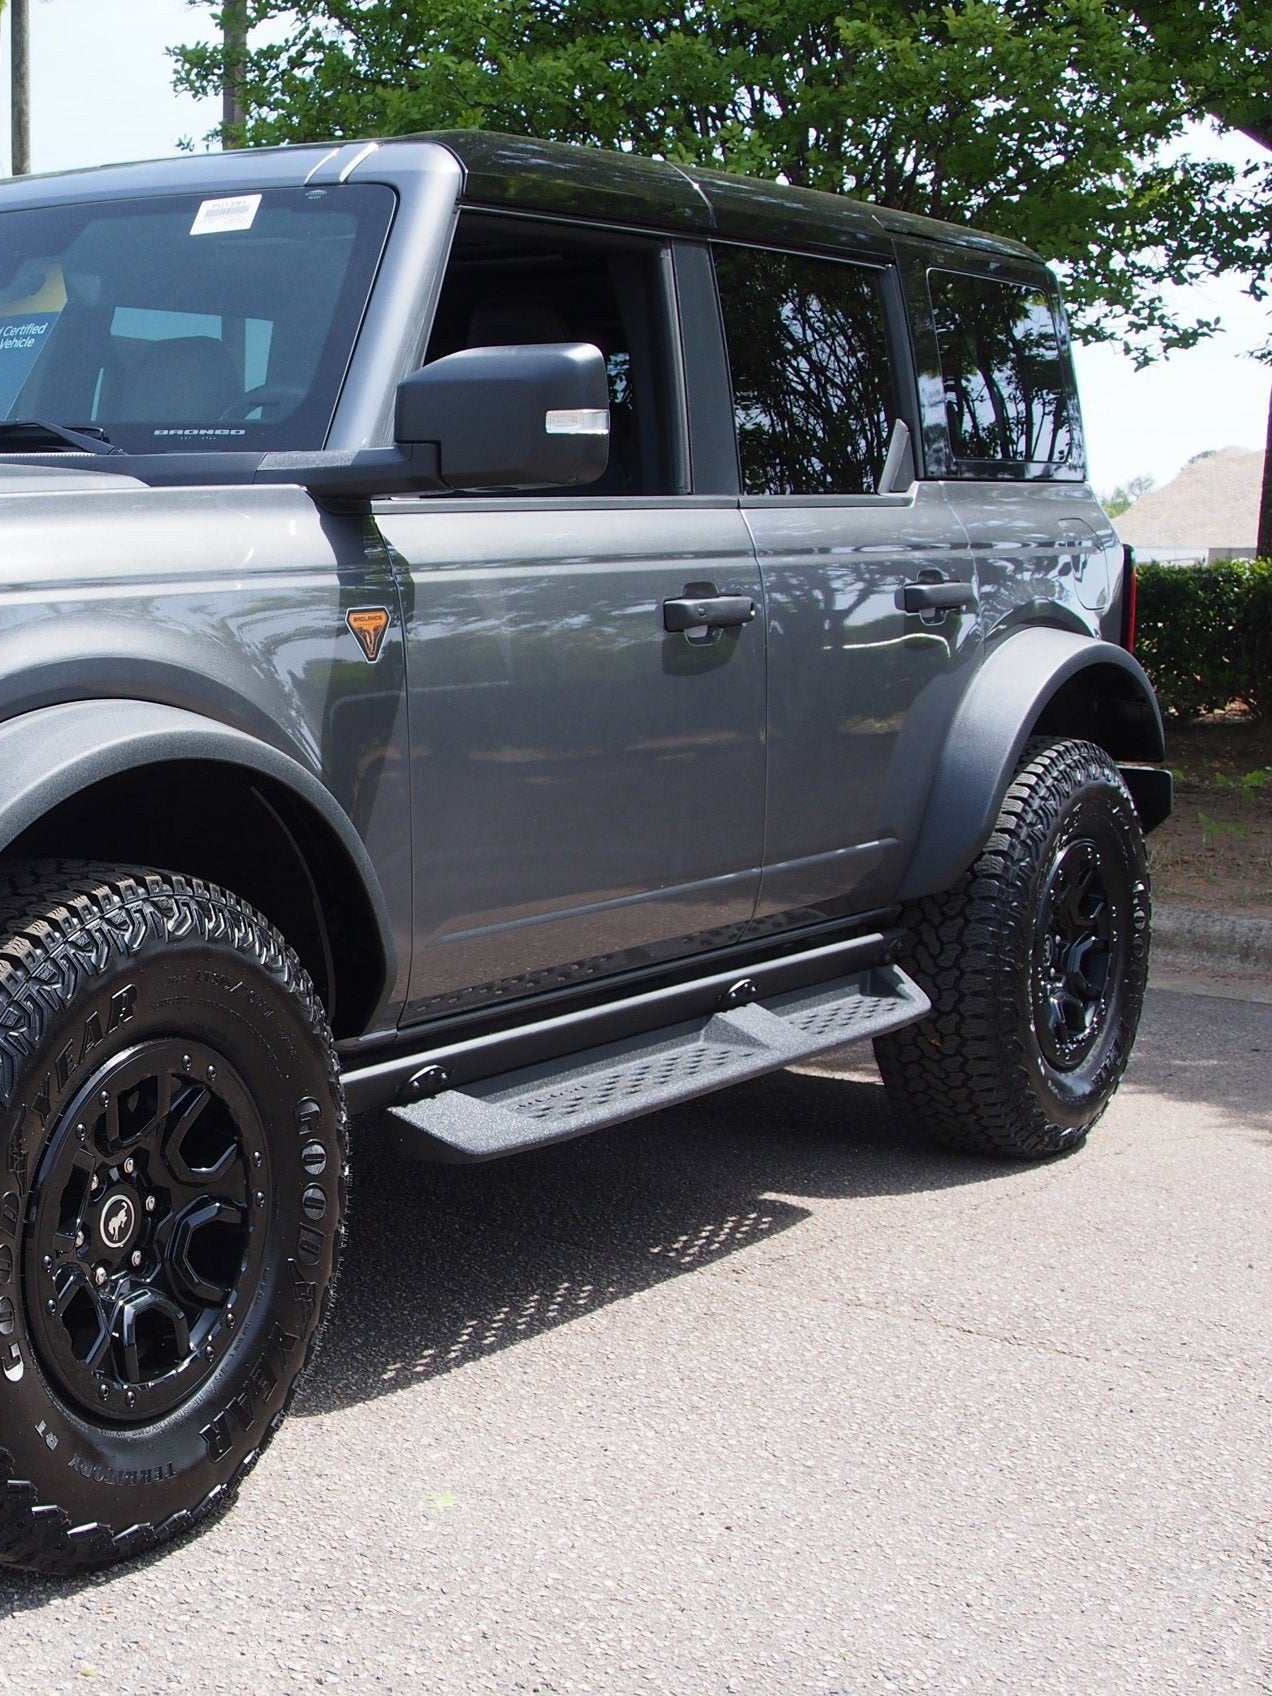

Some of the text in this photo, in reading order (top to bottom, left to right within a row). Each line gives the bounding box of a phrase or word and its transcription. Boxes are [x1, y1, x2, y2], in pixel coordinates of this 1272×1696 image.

[3, 322, 47, 336] Certified
[0, 337, 34, 349] Vehicle
[68, 1454, 177, 1487] TERRITORY
